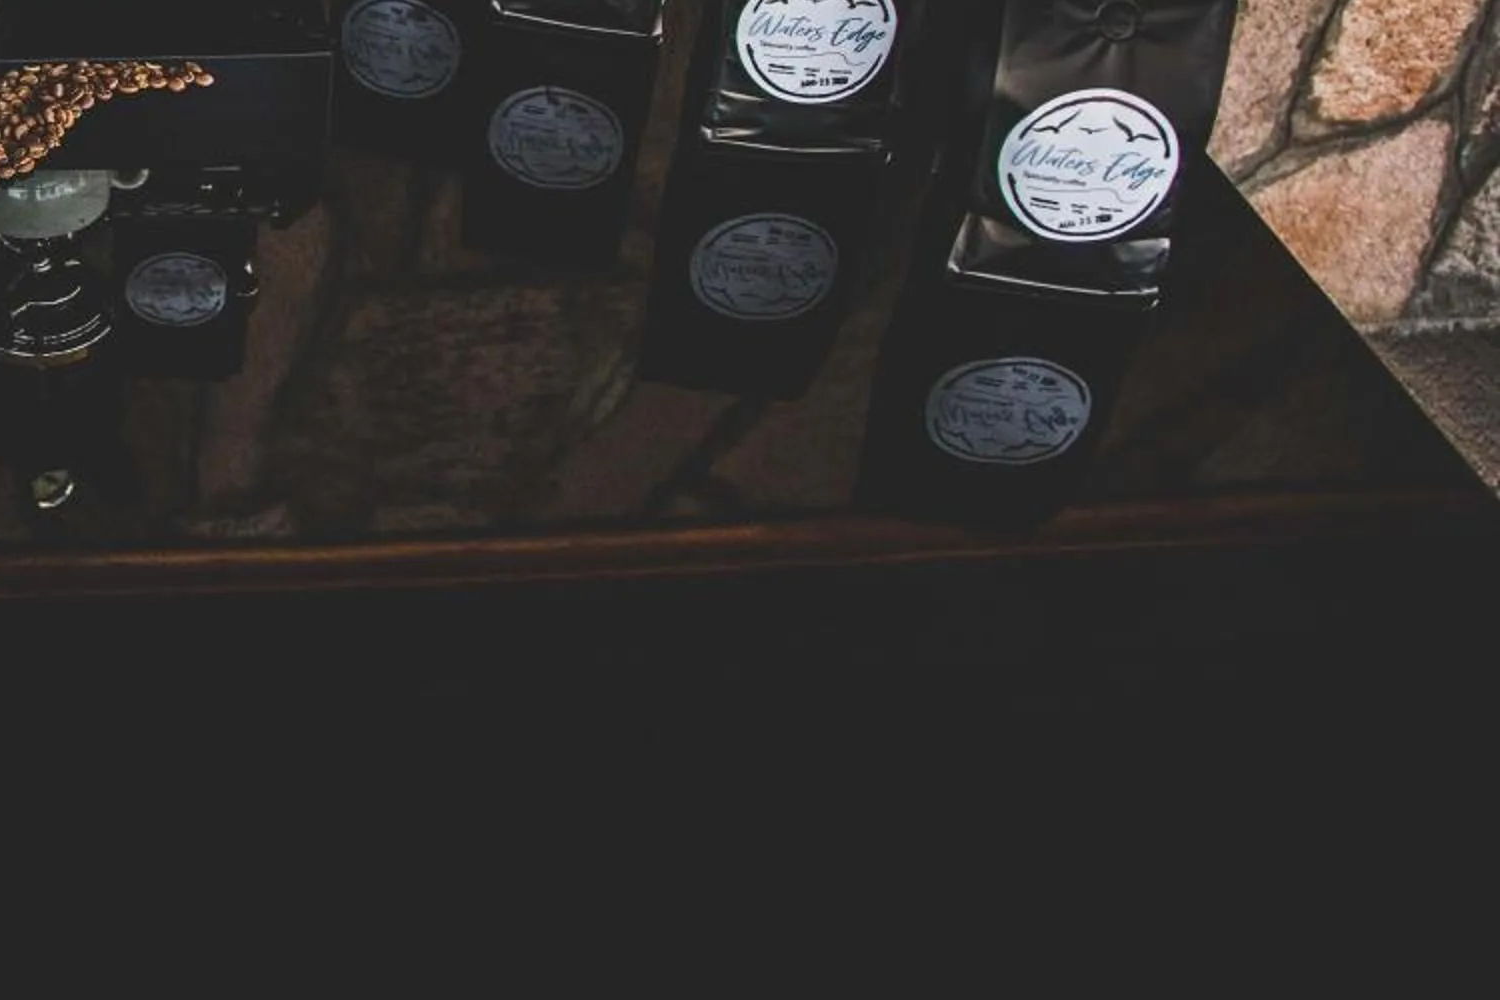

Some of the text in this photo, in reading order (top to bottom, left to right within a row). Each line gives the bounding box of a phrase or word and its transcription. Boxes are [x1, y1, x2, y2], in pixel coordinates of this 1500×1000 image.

[748, 11, 886, 53] Waters Edge
[1010, 139, 1167, 191] Waters Edge
